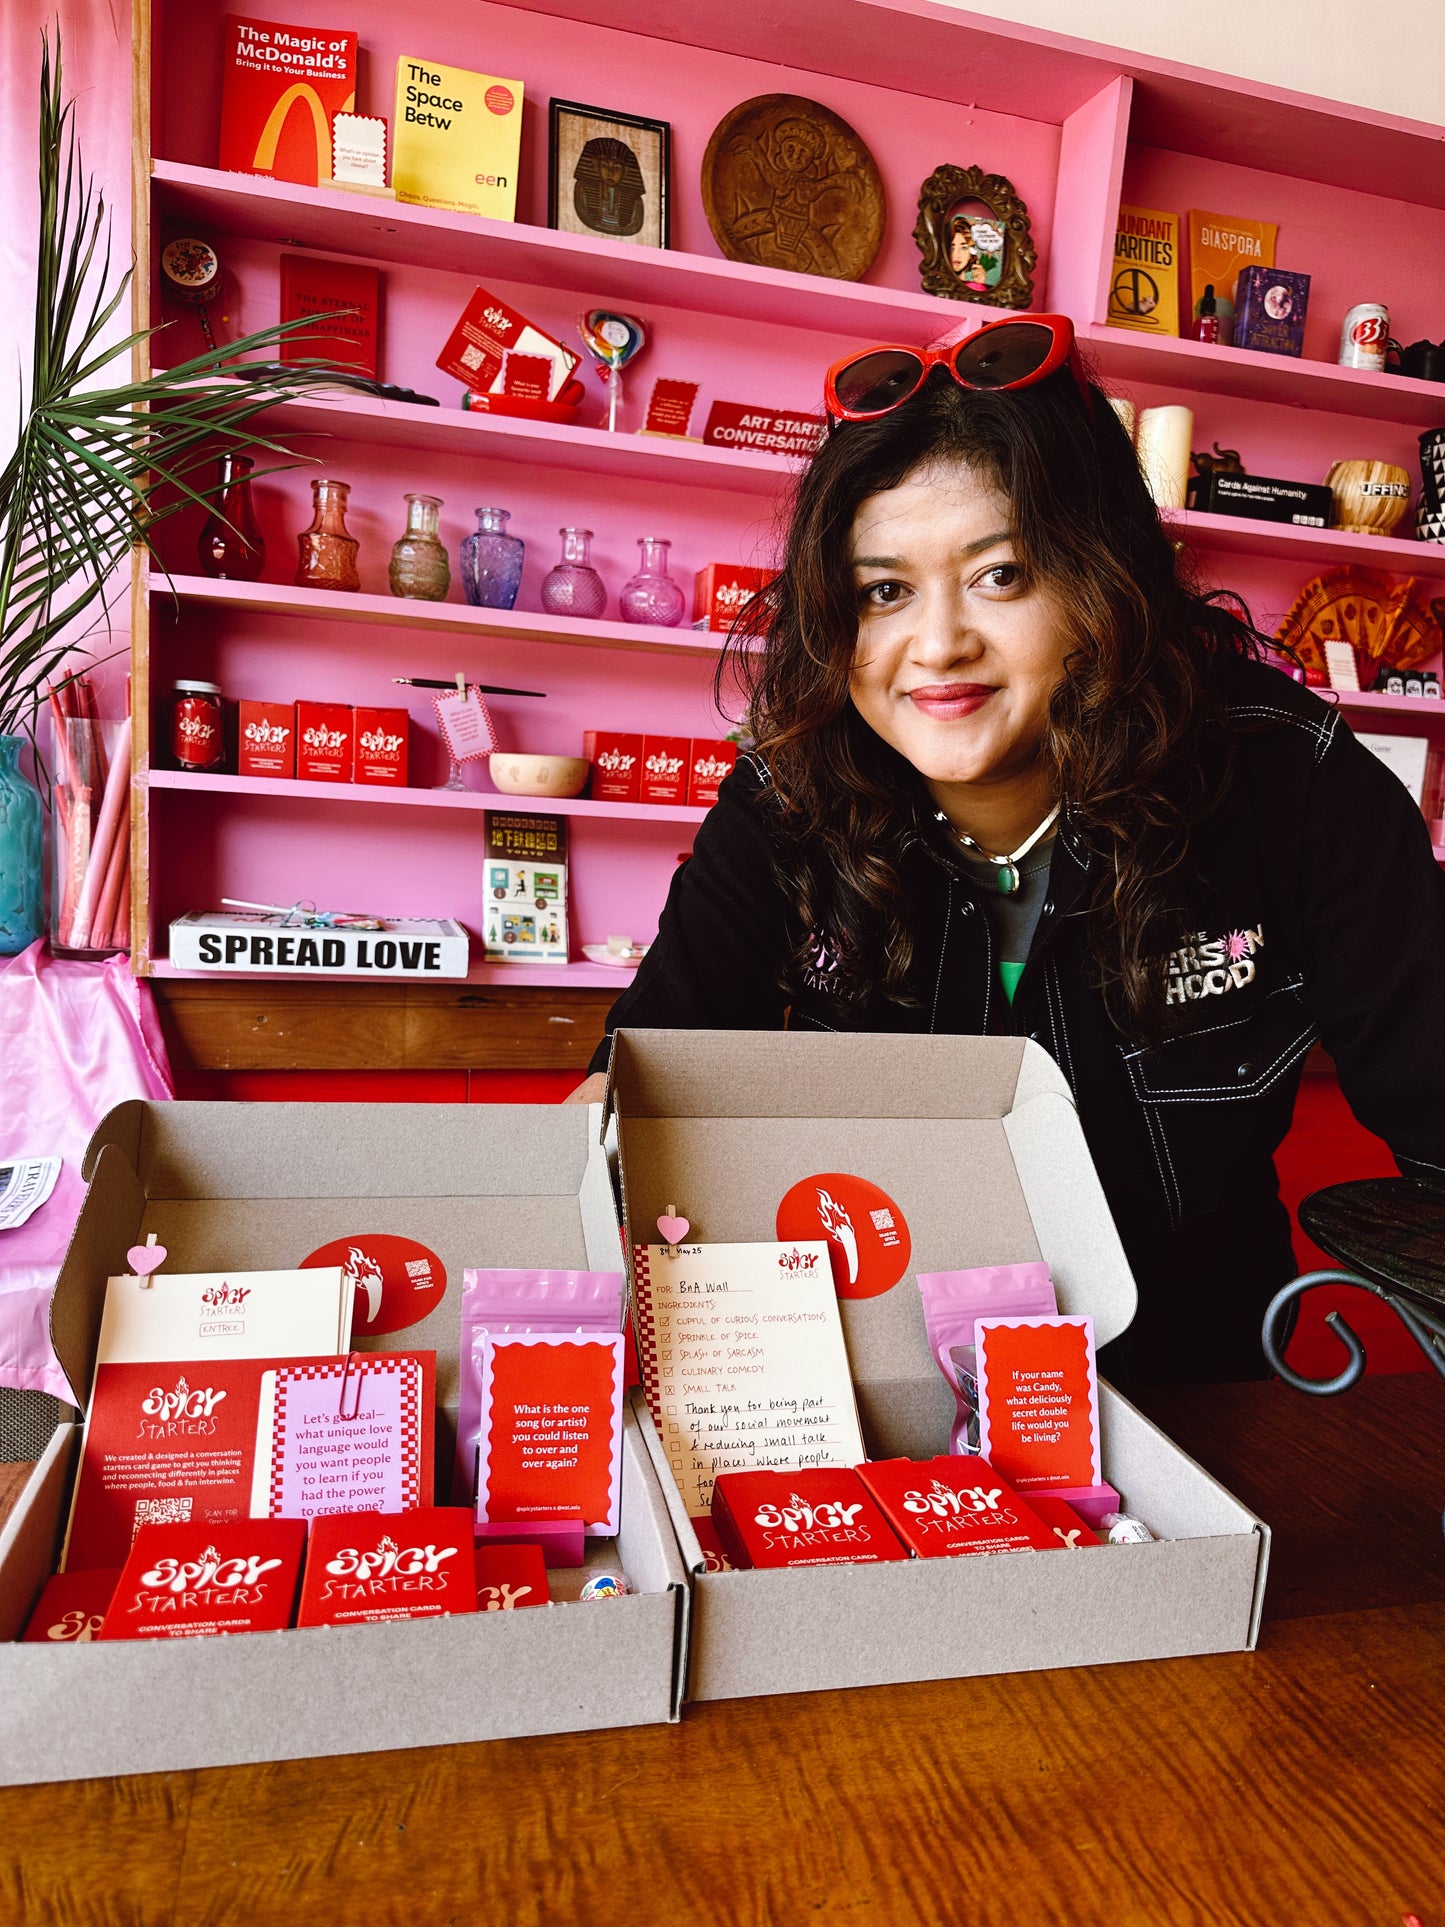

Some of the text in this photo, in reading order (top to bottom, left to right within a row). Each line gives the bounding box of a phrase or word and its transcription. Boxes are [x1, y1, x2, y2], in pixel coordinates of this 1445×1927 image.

[238, 25, 348, 51] The Magic of
[237, 42, 346, 68] McDonald's
[236, 58, 261, 70] Bring
[264, 63, 270, 71] it
[284, 66, 304, 75] Your
[306, 69, 345, 79] Business
[408, 64, 441, 86] The
[406, 86, 462, 111] Space
[405, 106, 451, 130] Betw
[475, 174, 506, 187] een
[1201, 227, 1261, 258] DIASPORA
[739, 414, 774, 430] ART
[1218, 479, 1241, 490] Cards
[1243, 483, 1270, 494] Against
[1272, 486, 1307, 500] Humanity
[180, 716, 215, 739] SPICY
[245, 719, 290, 741] SPICY
[303, 724, 347, 748] SPICY
[245, 741, 286, 753] STARTERS
[359, 728, 403, 751] SPICY
[303, 745, 344, 757] STARTERS
[359, 749, 400, 761] STARTERS
[199, 934, 441, 970] SPREAD LOVE
[1165, 960, 1256, 1004] HOOD
[779, 1249, 818, 1270] SPICY
[780, 1269, 818, 1280] STARTERS
[201, 1282, 251, 1305] SPICY
[679, 1281, 728, 1293] BnA Wall
[200, 1304, 246, 1316] STARTERS
[726, 1314, 758, 1325] CURIOUS
[763, 1312, 826, 1323] CONVERSATIONS
[678, 1334, 716, 1344] SPRINKLE
[735, 1332, 758, 1340] SPICE
[682, 1365, 764, 1376] CULINARY COMEDY
[1012, 1371, 1019, 1380] If
[1020, 1372, 1040, 1381] your
[1015, 1382, 1062, 1393] was Candy,
[142, 1382, 227, 1421] SPICY
[514, 1404, 590, 1414] What is the one
[1006, 1394, 1072, 1406] what deliciously
[685, 1396, 823, 1428] Thank you for being part
[137, 1416, 219, 1439] STARTERS
[296, 1425, 393, 1439] what unique love
[515, 1417, 587, 1429] song (or artist)
[690, 1414, 830, 1438] of our social movement
[299, 1439, 388, 1455] language would
[512, 1431, 589, 1444] you could listen
[151, 1462, 171, 1472] game
[183, 1461, 194, 1469] get
[196, 1461, 210, 1469] you
[211, 1459, 241, 1467] thinking
[156, 1452, 188, 1461] designed
[296, 1453, 391, 1472] you want people
[303, 1471, 383, 1484] to learn if you
[301, 1485, 386, 1501] had the power
[903, 1484, 1002, 1517] SPICY
[755, 1498, 863, 1532] SPICY
[916, 1508, 1018, 1534] STARTERS
[763, 1525, 871, 1549] STARTERS
[946, 1538, 1004, 1549] CONVERSATION
[326, 1541, 458, 1580] SPICY
[788, 1556, 850, 1565] CONVERSATION
[141, 1550, 282, 1592] SPICY
[320, 1571, 450, 1600] STARTERS
[127, 1584, 268, 1613] STARTERS
[335, 1608, 409, 1618] CONVERSATION
[138, 1621, 216, 1633] CONVERSATION
